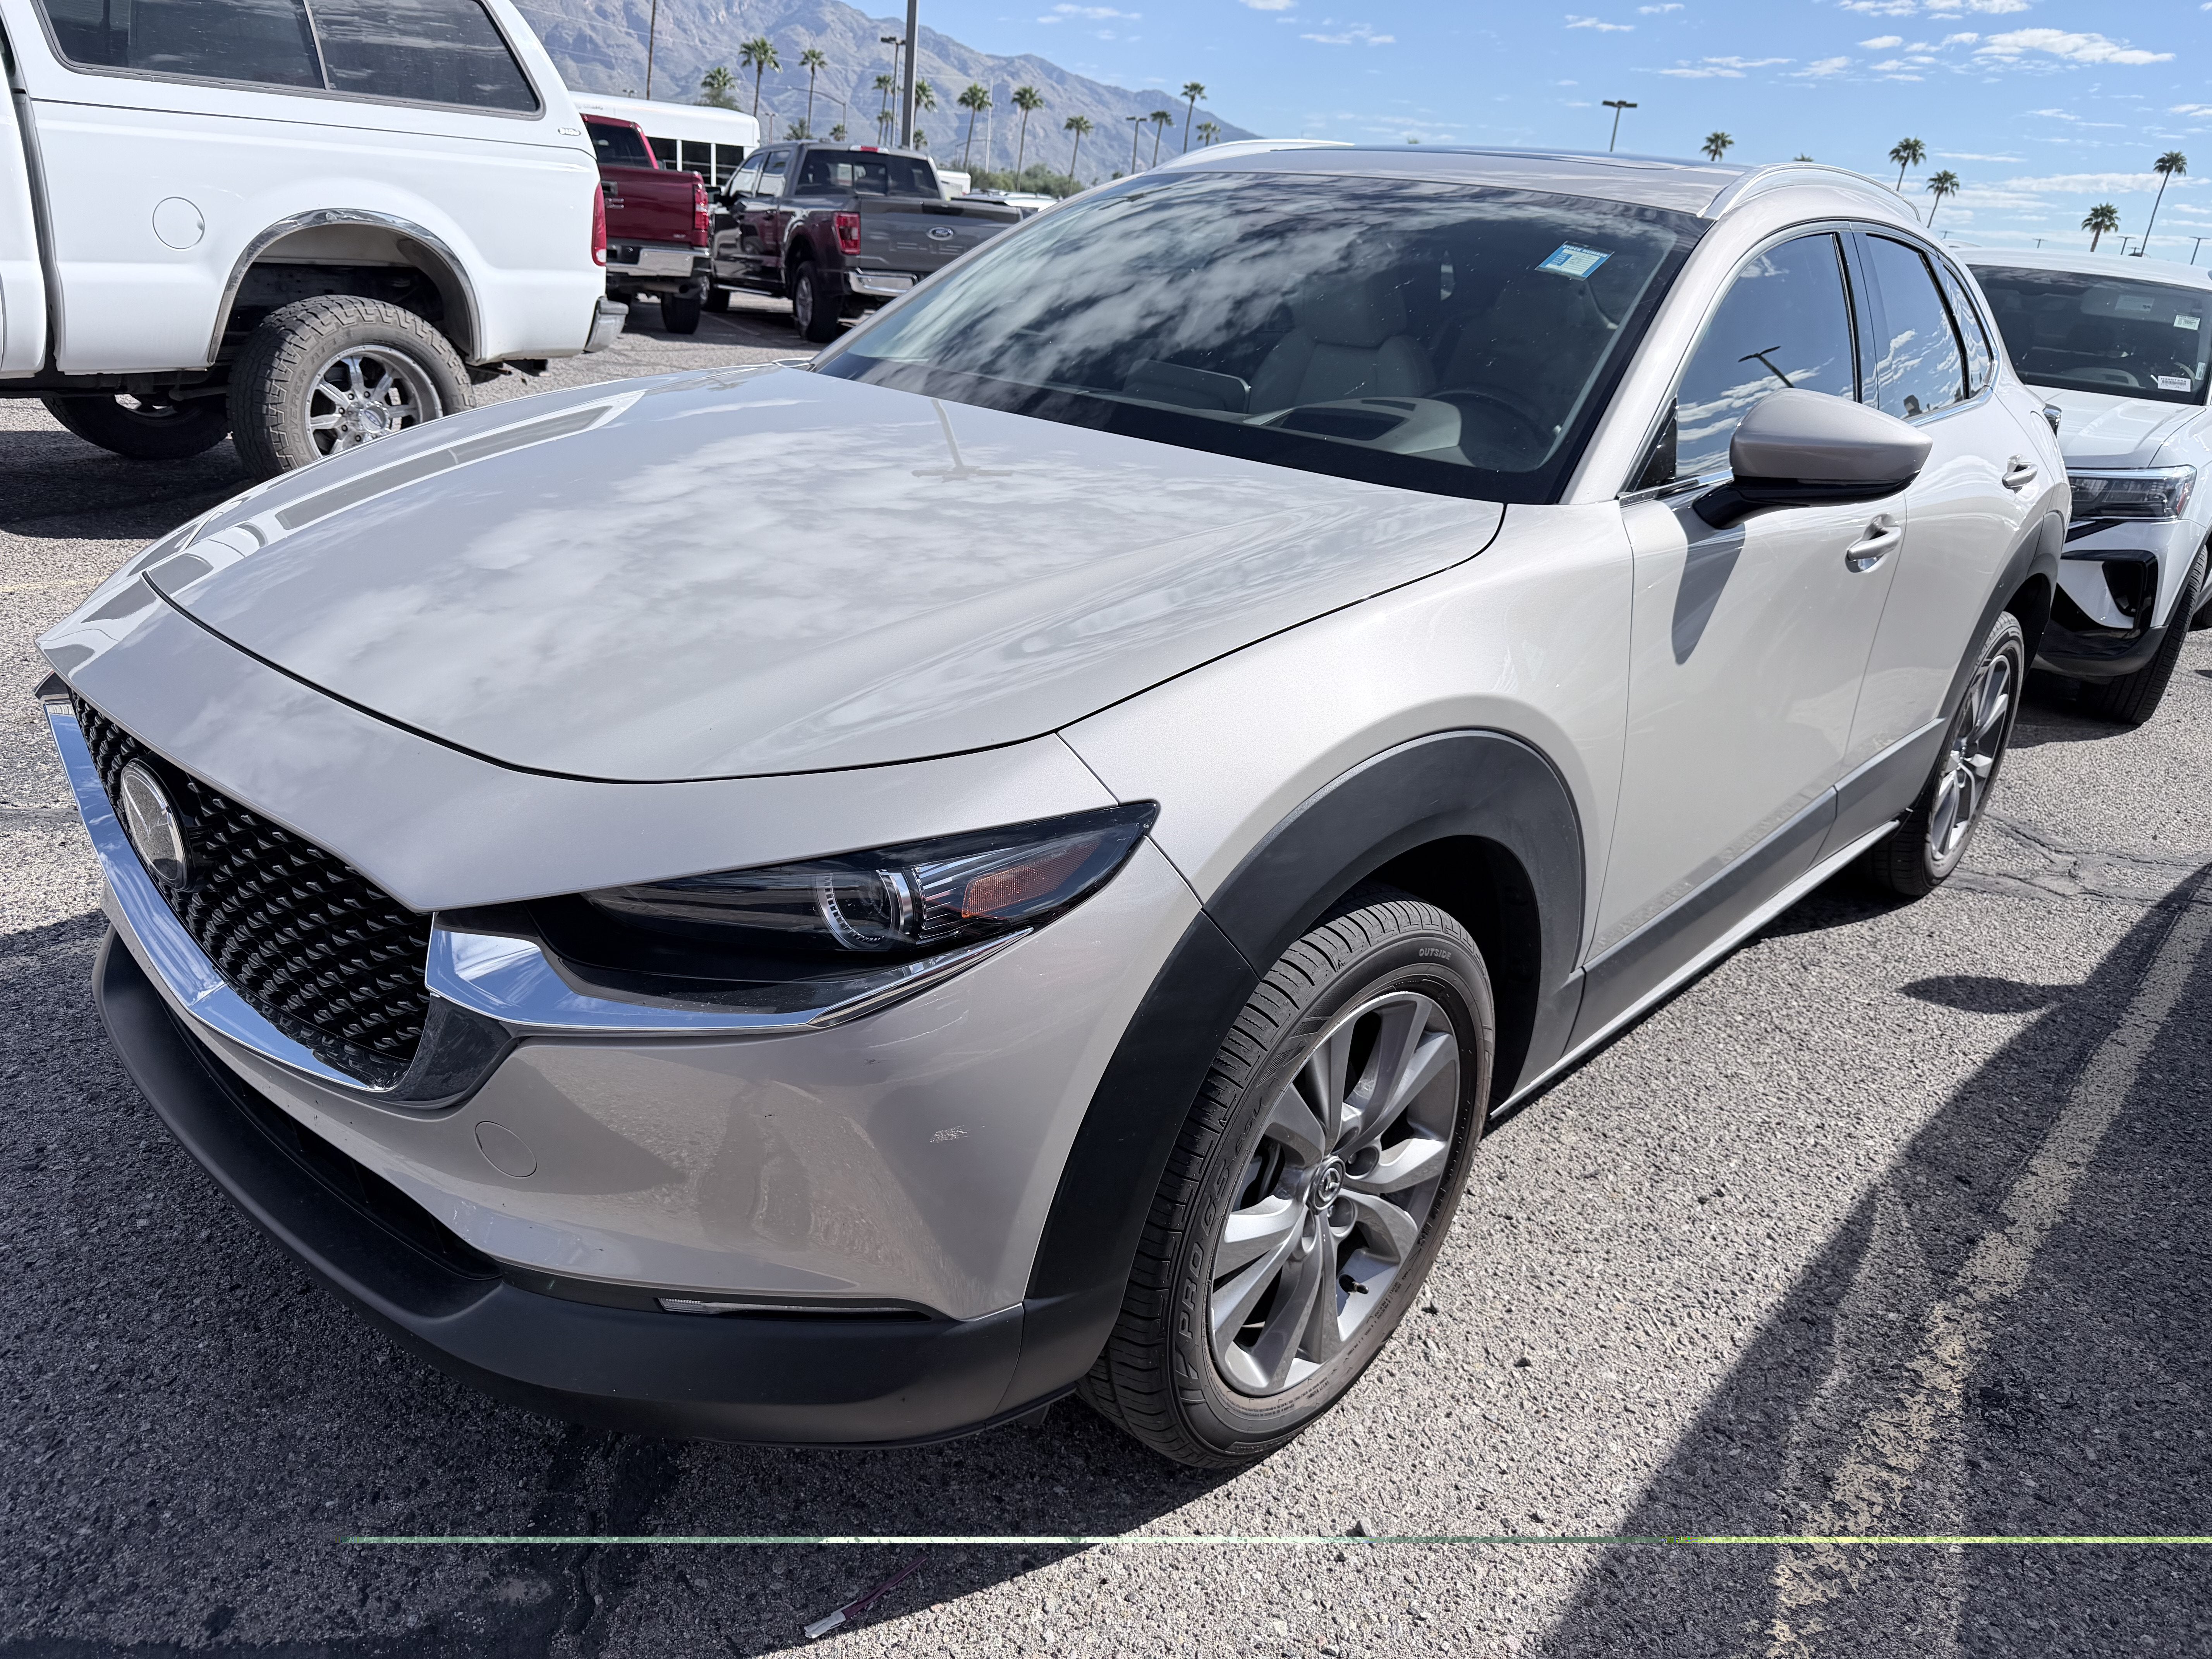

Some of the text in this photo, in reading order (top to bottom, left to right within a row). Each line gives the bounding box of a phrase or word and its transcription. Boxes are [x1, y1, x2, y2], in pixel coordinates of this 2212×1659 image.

[889, 241, 976, 256] F-15
[1582, 248, 1608, 258] NUMBER
[1419, 948, 1451, 960] OUTSIDE
[1179, 1241, 1204, 1340] PRO
[1201, 1158, 1230, 1236] G5
